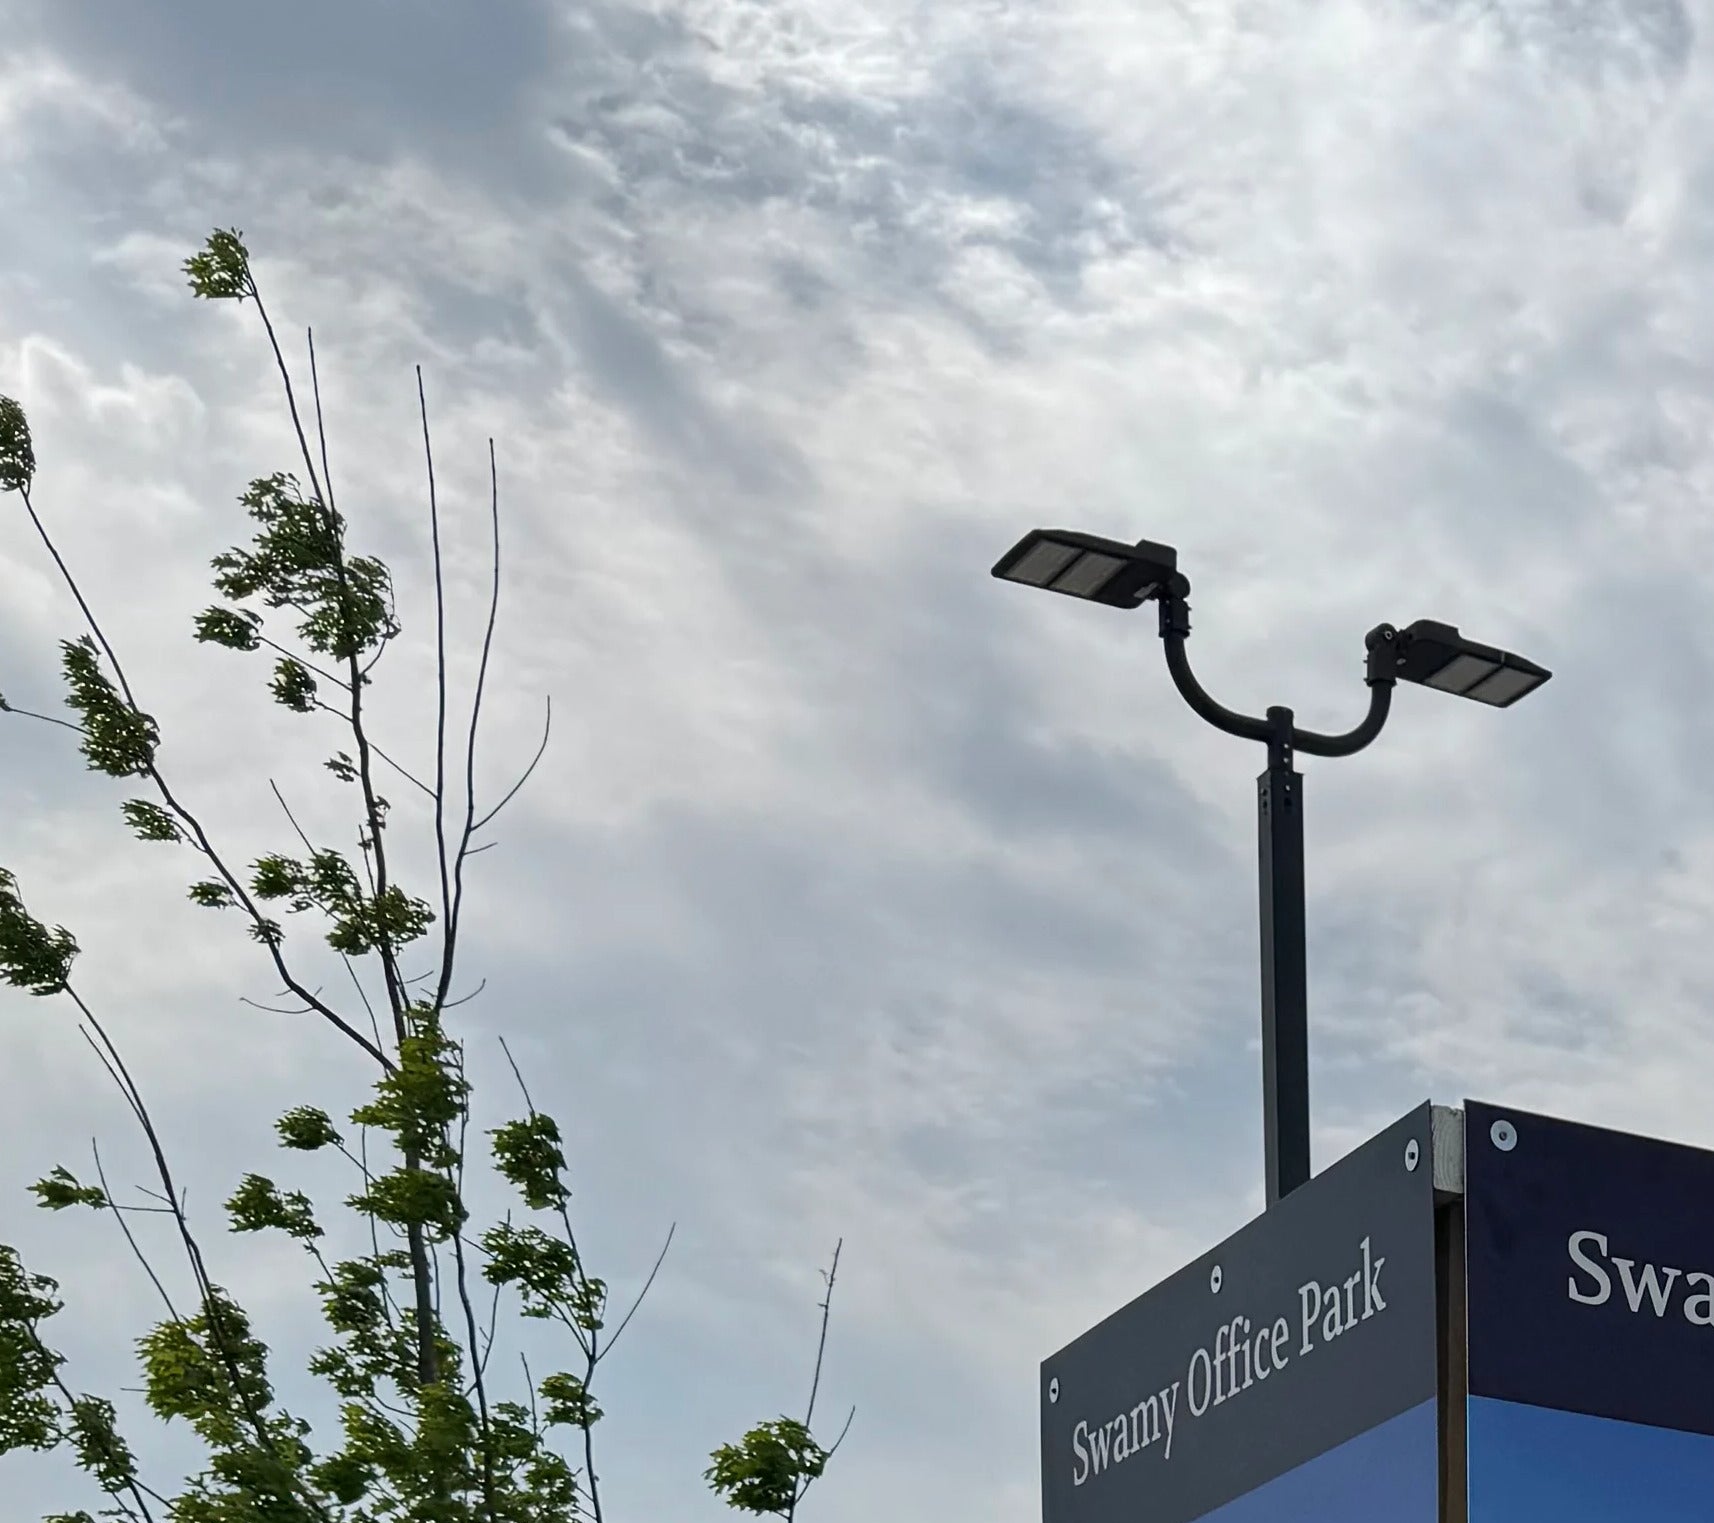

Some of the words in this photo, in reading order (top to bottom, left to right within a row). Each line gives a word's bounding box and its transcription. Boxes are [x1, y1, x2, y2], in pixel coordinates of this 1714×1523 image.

[1073, 1381, 1180, 1486] Swamy
[1187, 1315, 1289, 1417] Office
[1297, 1236, 1387, 1357] Park
